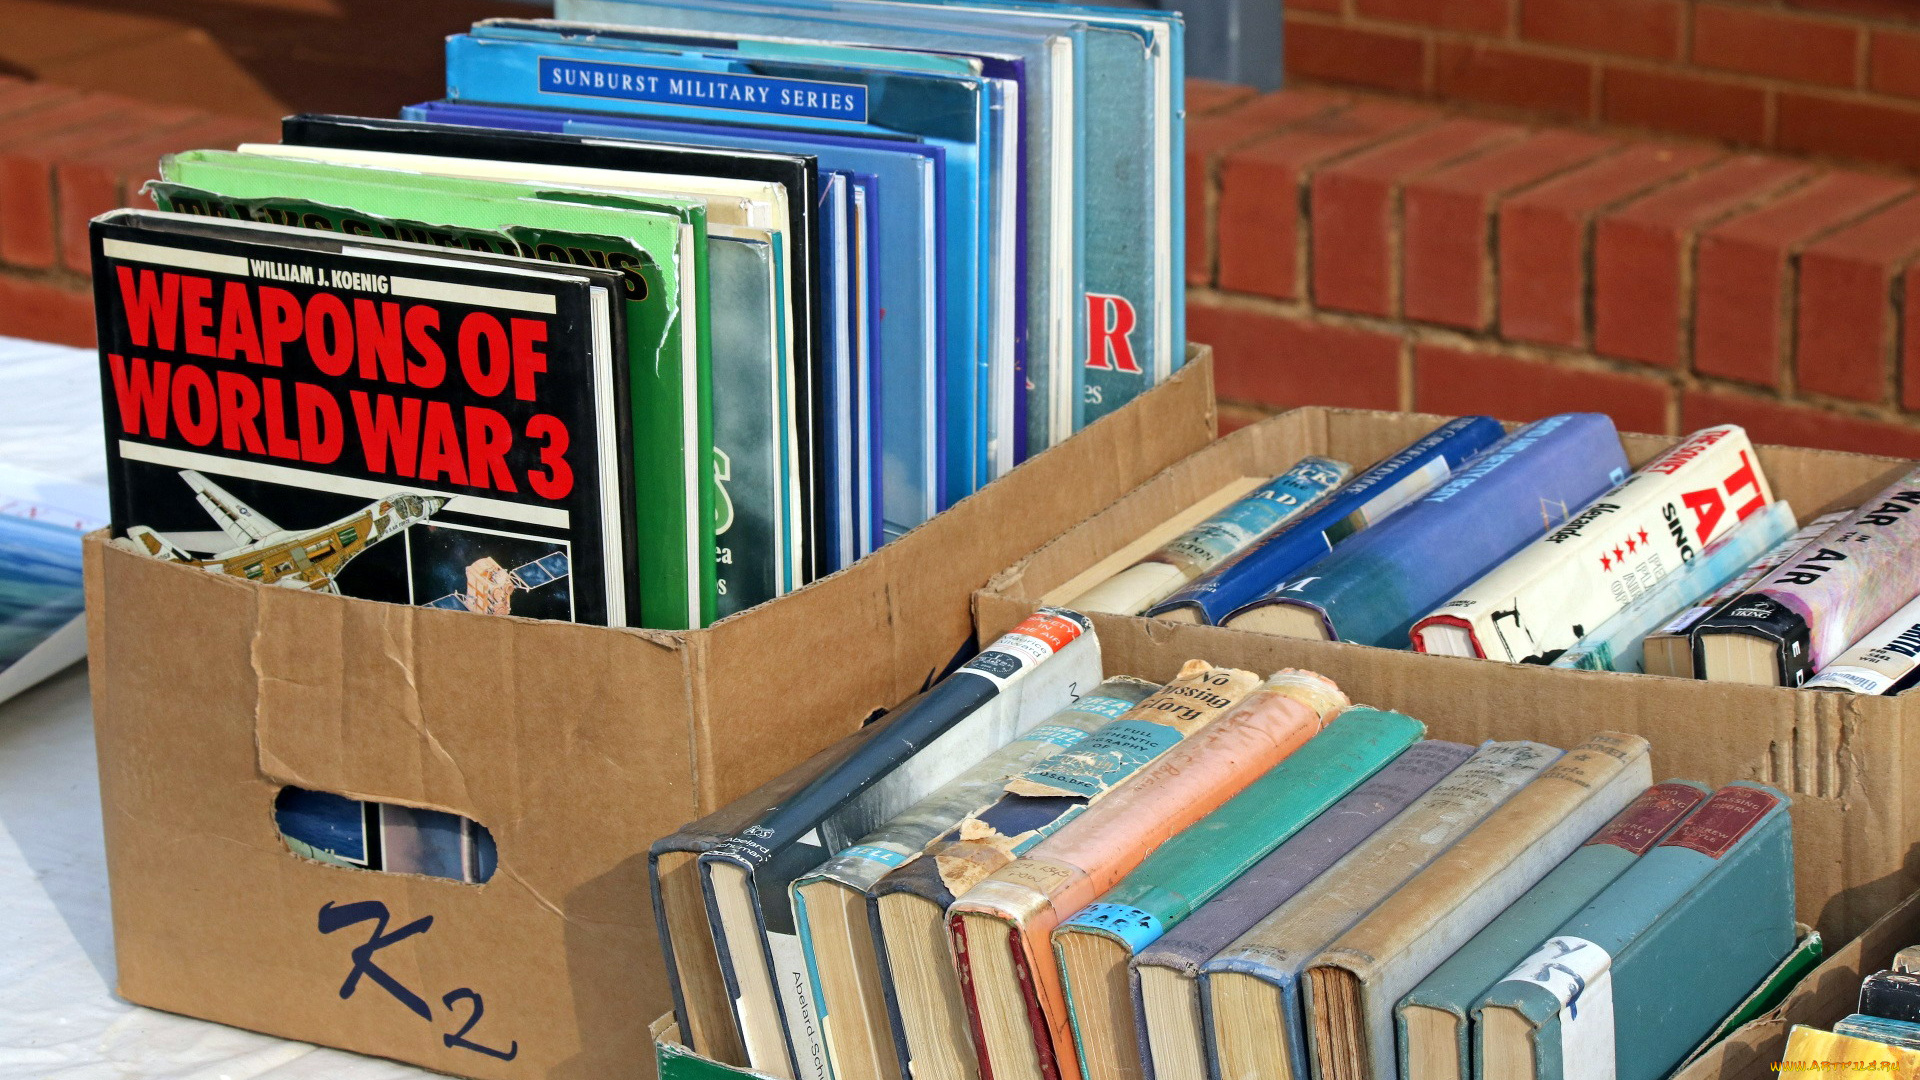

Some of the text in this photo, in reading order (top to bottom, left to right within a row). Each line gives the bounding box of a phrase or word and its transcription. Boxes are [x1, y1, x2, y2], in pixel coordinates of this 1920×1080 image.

[552, 67, 855, 112] SUNBURST MILITARY SERIES
[250, 258, 389, 294] WILLIAM J. KOENIG
[115, 264, 548, 401] WEAPONS OF
[108, 353, 574, 500] WORLD WAR 3
[1546, 502, 1621, 544] Alexander
[1774, 547, 1848, 586] AIR
[1037, 623, 1052, 631] IN
[1730, 610, 1771, 620] VIKING
[1039, 630, 1061, 646] AIR
[1124, 727, 1152, 738] FULL
[724, 837, 770, 853] Abelard
[318, 900, 518, 1062] K 2
